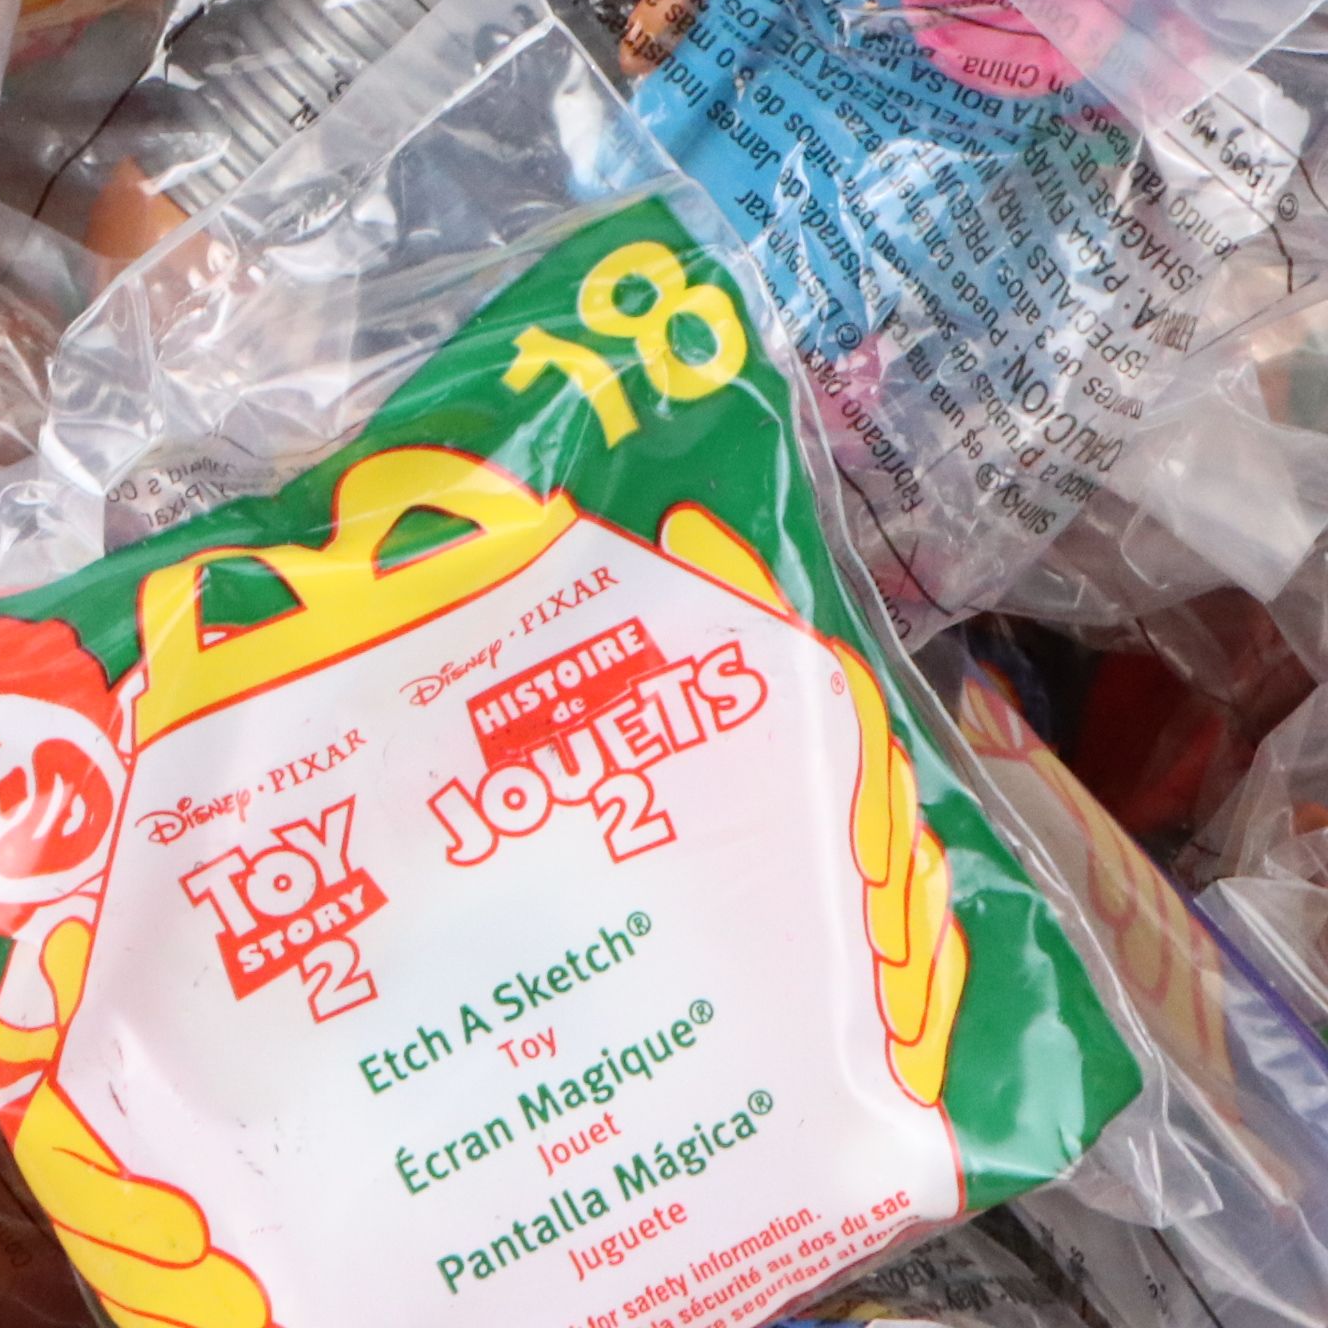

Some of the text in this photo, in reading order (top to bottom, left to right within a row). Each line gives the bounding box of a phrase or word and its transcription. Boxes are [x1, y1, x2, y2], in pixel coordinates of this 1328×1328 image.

[664, 3, 718, 52] más
[772, 28, 818, 68] DE
[706, 99, 782, 170] James
[752, 85, 785, 116] de
[910, 60, 1002, 119] BOLSA
[1023, 138, 1075, 223] EVITAR
[500, 238, 750, 448] 18
[951, 271, 1010, 348] Puede
[1026, 247, 1150, 379] ESPECIALES
[841, 402, 924, 514] Fabricado
[929, 382, 984, 459] una es
[399, 566, 619, 706] Disney PIXAR
[474, 624, 648, 734] HISTOIRE
[428, 641, 768, 866] JOUETS
[551, 696, 587, 723] de
[135, 728, 367, 846] Disney PIXAR
[591, 770, 676, 863] 2
[179, 796, 356, 938] TOY
[237, 885, 370, 974] STORY
[299, 933, 378, 1023] 2
[358, 912, 652, 1095] Etch A Sketch®
[497, 1027, 558, 1070] Toy
[395, 1000, 714, 1195] Écran Magique®
[537, 1112, 622, 1176] Jouet
[436, 1090, 774, 1294] Pantalla Mágica®
[568, 1199, 689, 1281] Juguete
[587, 1306, 619, 1328] for
[623, 1270, 690, 1320] safety
[690, 1211, 823, 1284] information.
[680, 1189, 912, 1326] sécurité au dos du sac
[731, 1244, 859, 1319] seguridad al
